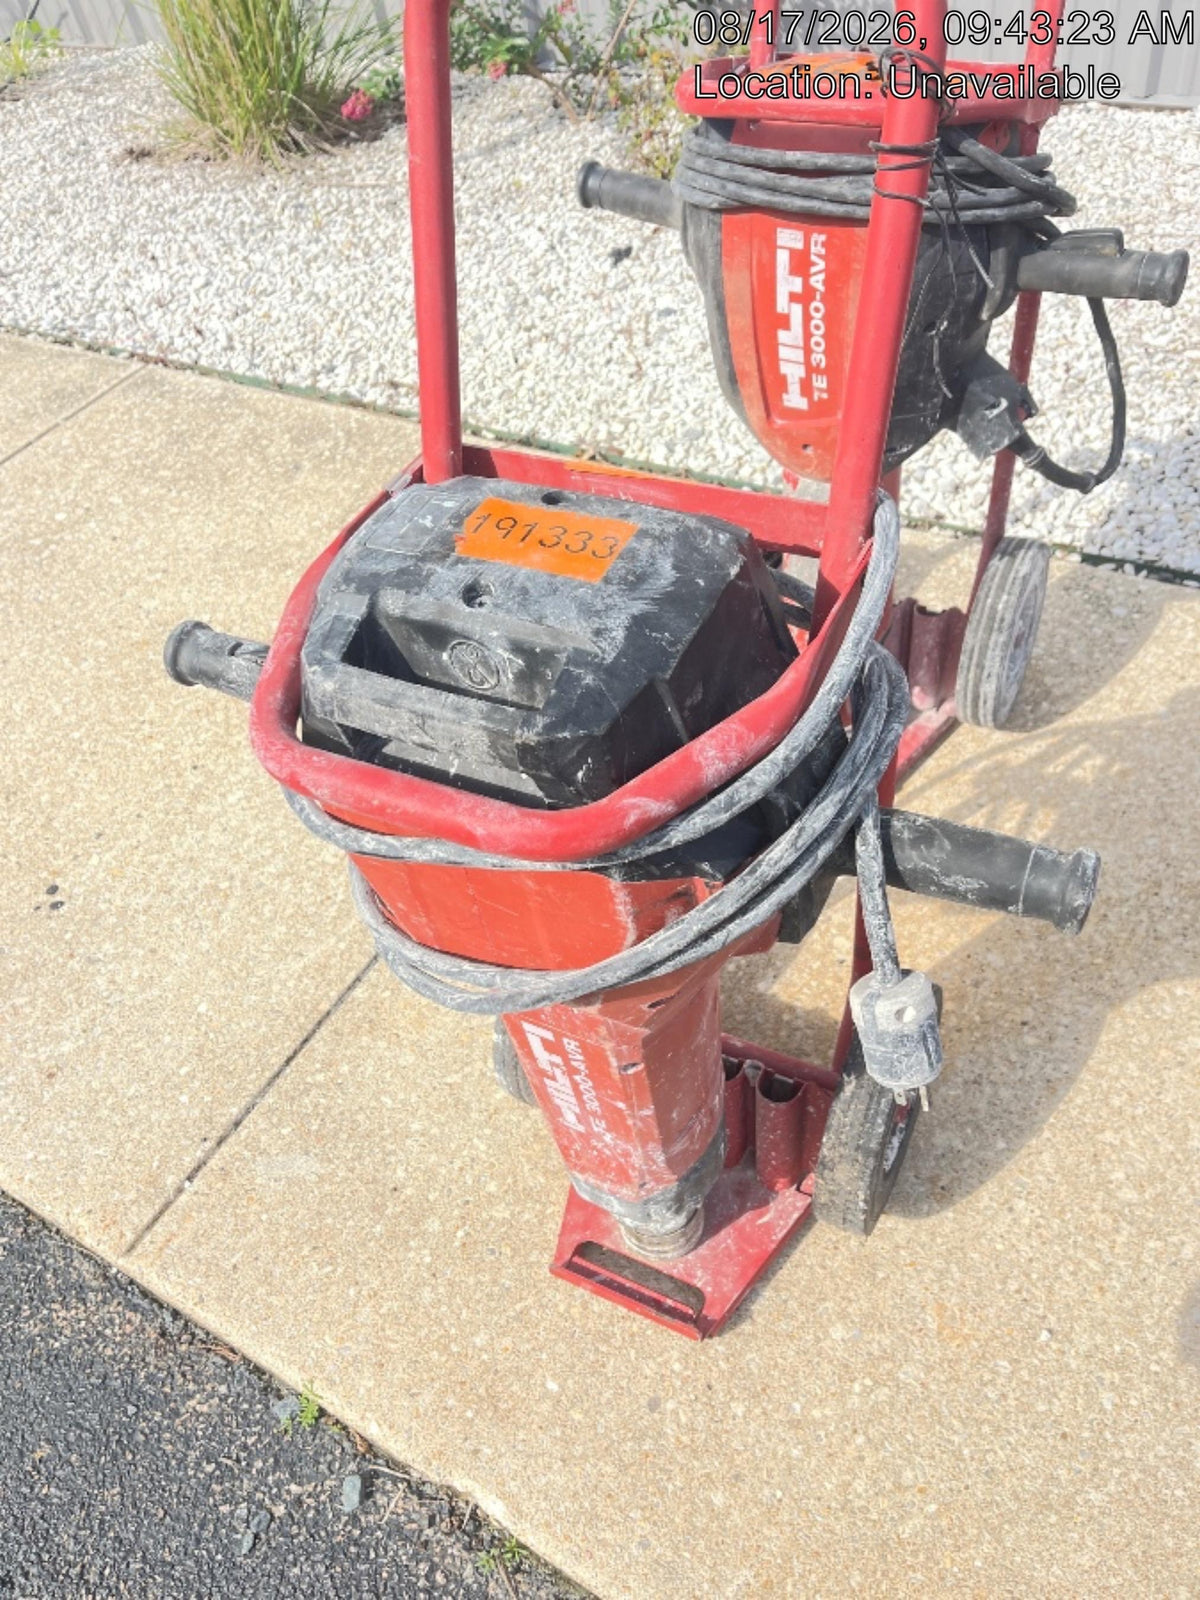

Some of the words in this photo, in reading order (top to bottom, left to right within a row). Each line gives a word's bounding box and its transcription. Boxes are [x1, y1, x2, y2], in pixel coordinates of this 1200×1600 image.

[776, 227, 809, 411] HILTI
[809, 232, 827, 369] 3000-AVR
[812, 372, 829, 402] TE
[473, 512, 619, 559] 191333
[521, 1020, 586, 1133] HILTI
